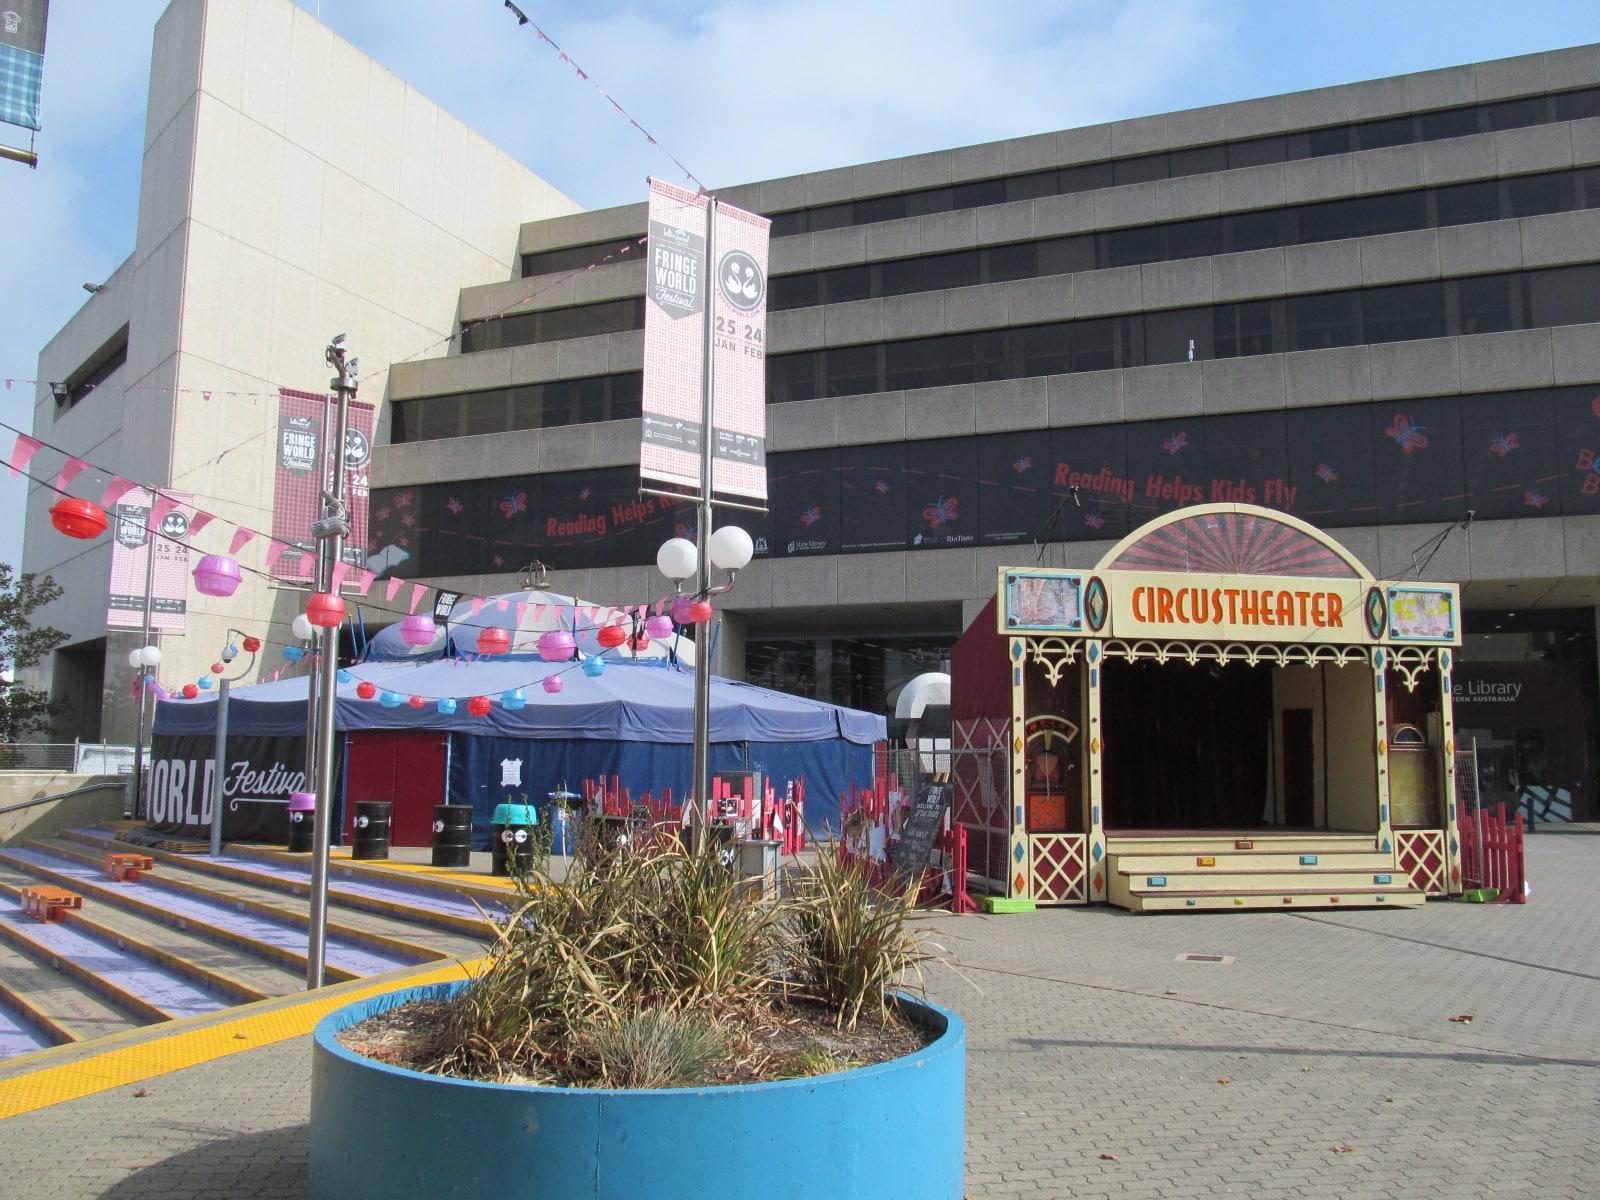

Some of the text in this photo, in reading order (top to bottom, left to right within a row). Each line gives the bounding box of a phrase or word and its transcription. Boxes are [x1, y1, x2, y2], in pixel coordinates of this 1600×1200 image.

[655, 248, 697, 277] FRINGE
[655, 266, 697, 295] WORLD
[655, 288, 695, 308] Festival
[716, 315, 762, 343] 25 24
[715, 338, 763, 360] JAN FEB
[283, 432, 316, 448] FRINGE
[283, 445, 316, 459] WORLD
[352, 475, 369, 486] 24
[1054, 462, 1297, 511] Reading Helps Kids Fly
[352, 488, 368, 497] FEB
[547, 513, 607, 537] Reading
[611, 498, 655, 525] Helps
[120, 525, 146, 536] WORLD
[157, 544, 188, 554] 25 24
[1468, 680, 1522, 698] Library
[223, 760, 310, 796] Festiva
